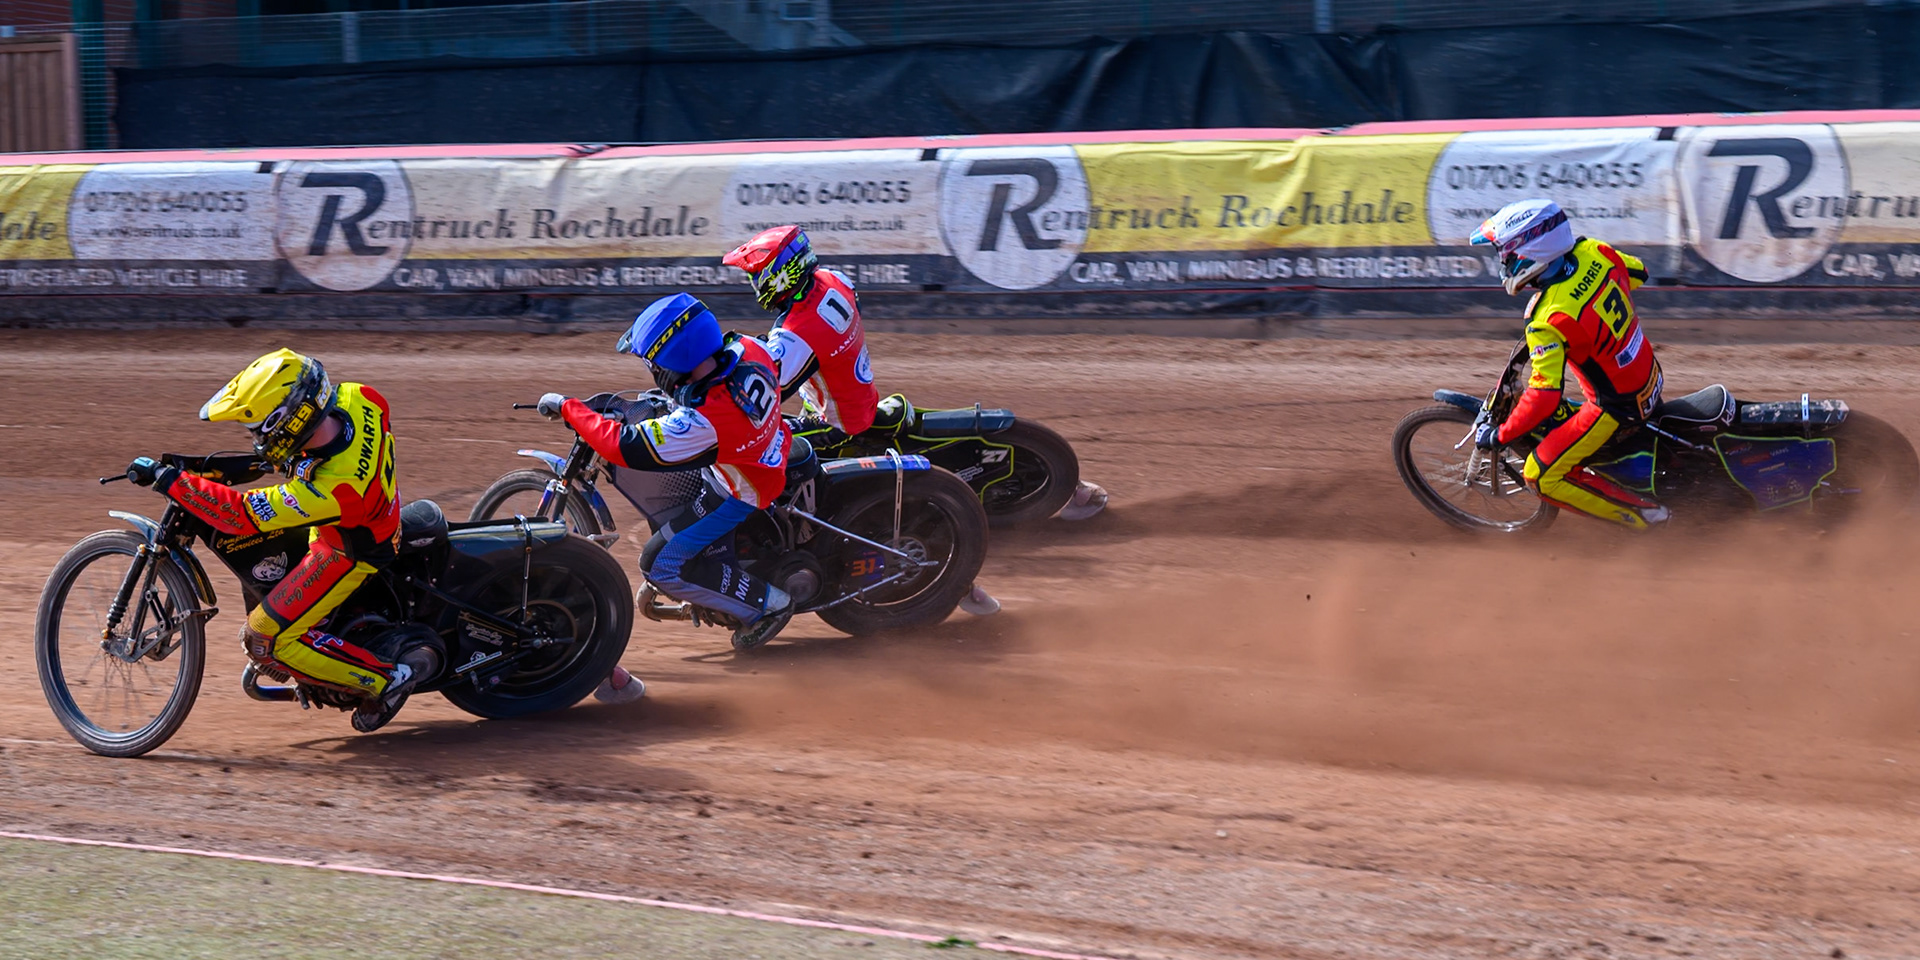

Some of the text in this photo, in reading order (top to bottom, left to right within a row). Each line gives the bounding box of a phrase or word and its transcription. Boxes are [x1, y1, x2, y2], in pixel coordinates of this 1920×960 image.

[1446, 162, 1644, 190] 01706 640055
[737, 180, 912, 206] 01706 640055
[965, 158, 1415, 251] Rentruck Rochdale
[300, 172, 709, 256] Rentruck Rochdale
[503, 266, 599, 287] MINIBUS
[600, 266, 619, 286] &
[1188, 258, 1292, 280] MINIBUS
[1295, 256, 1316, 278] &
[1317, 255, 1481, 279] REFRIGERATED
[1569, 260, 1603, 301] MORRIS
[826, 297, 850, 322] 1
[1603, 286, 1629, 334] 3
[646, 310, 691, 361] SCOTT
[746, 378, 774, 423] 2
[287, 403, 315, 434] 29
[353, 405, 376, 482] HOWARTH
[981, 449, 1008, 464] 27
[178, 477, 240, 517] Complete Car
[181, 491, 245, 530] Services Ltd
[248, 494, 270, 521] SKIPS
[226, 528, 285, 554] Services Ltd
[851, 557, 877, 577] 31
